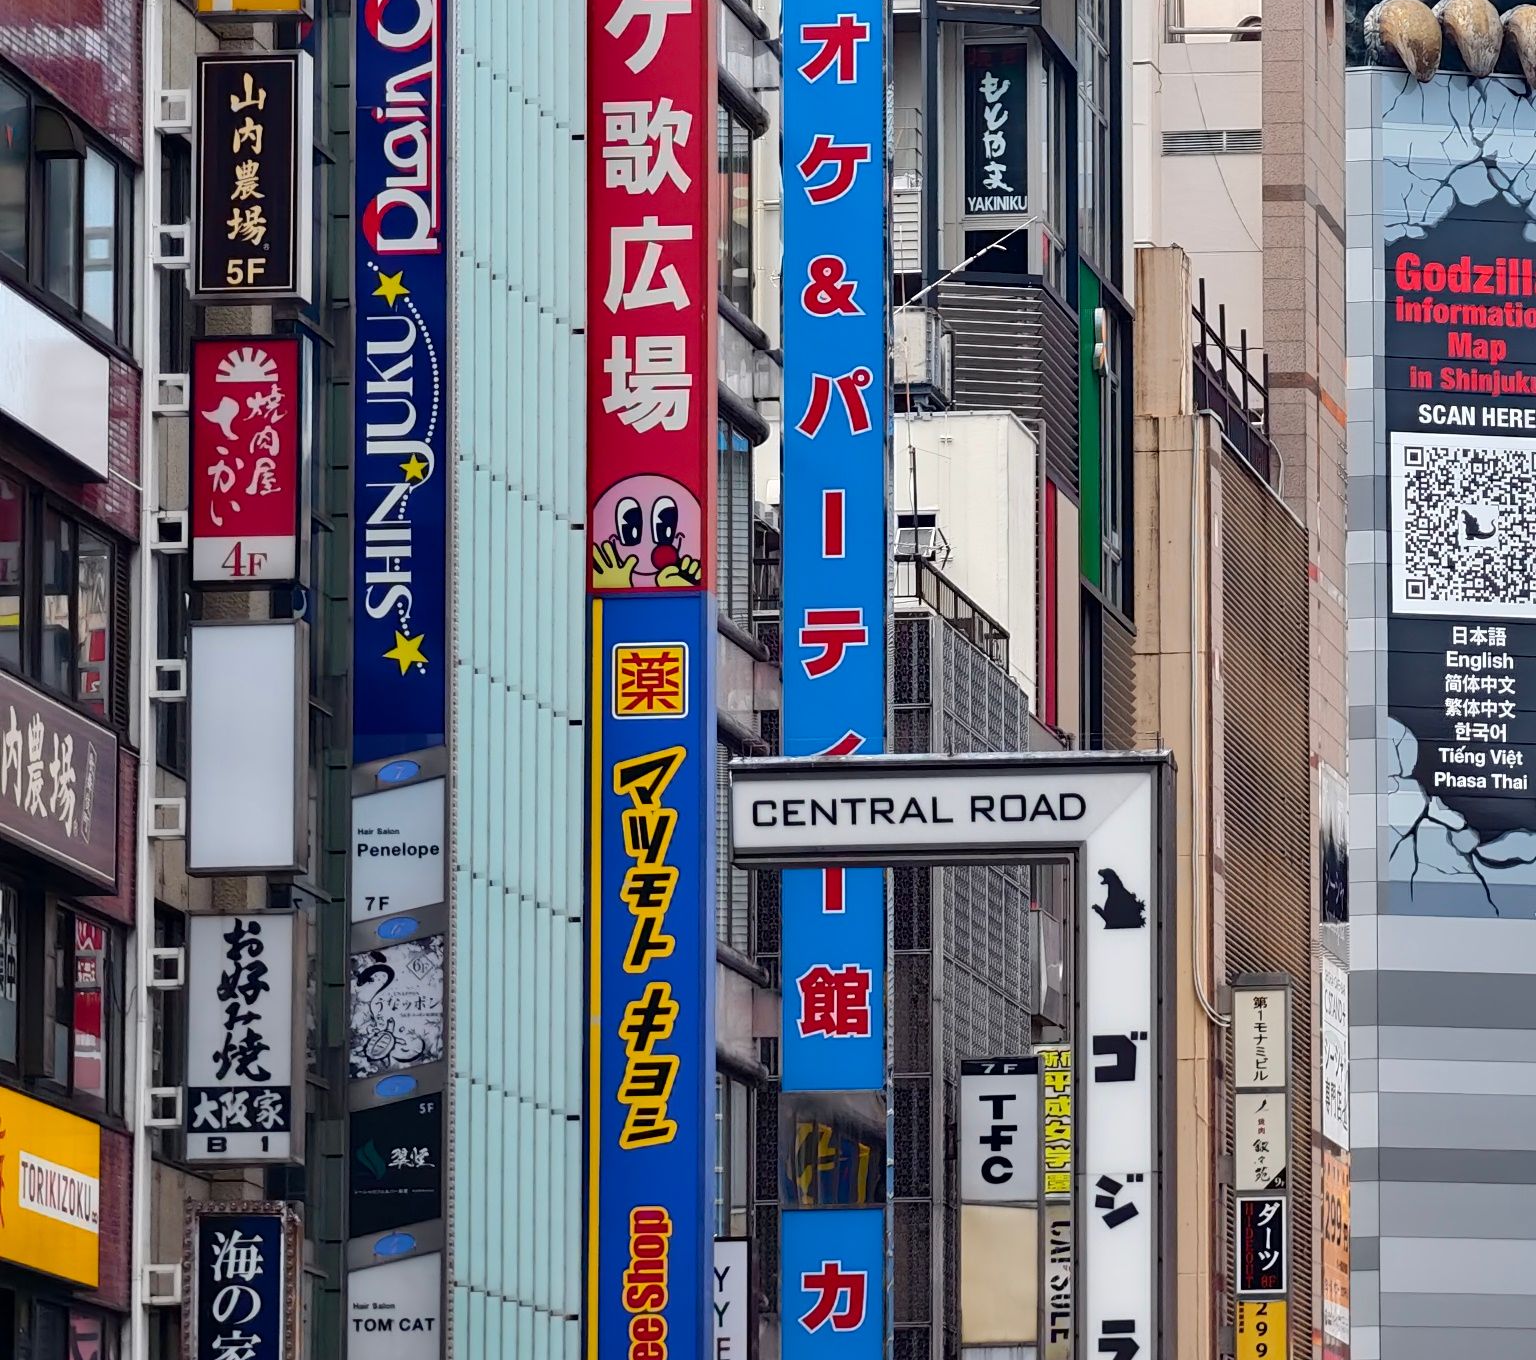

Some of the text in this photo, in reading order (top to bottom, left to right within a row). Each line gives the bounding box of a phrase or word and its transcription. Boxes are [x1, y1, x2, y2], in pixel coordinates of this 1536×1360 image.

[227, 73, 269, 248] 山内農場
[967, 195, 1028, 213] YAKINIKU
[226, 257, 266, 285] 5F
[1447, 330, 1508, 363] Map
[1409, 365, 1434, 391] in
[1417, 404, 1536, 430] SCAN HERE
[365, 314, 432, 621] SHINJUKU
[220, 539, 269, 579] 4F
[1452, 625, 1507, 647] 日本語
[1446, 650, 1514, 672] English
[619, 650, 683, 711] 薬
[1445, 674, 1516, 695] 简体中文
[1445, 697, 1516, 719] 繁体中文
[1454, 722, 1508, 743] 한국어
[1438, 745, 1524, 769] Tiếng Việt
[1434, 771, 1528, 790] Phasa Thai
[752, 792, 1087, 828] CENTRAL ROAD
[357, 842, 440, 859] Penelope
[365, 896, 390, 911] 7F
[612, 746, 687, 1150] マツモトキヨシ
[212, 918, 272, 1083] お好み焼
[1252, 996, 1269, 1081] 第1モナミビル
[980, 1063, 1018, 1075] 7F
[192, 1090, 286, 1132] 大阪家
[419, 1103, 435, 1114] 5F
[20, 1157, 92, 1224] TORIKIZOKU
[1257, 1201, 1281, 1271] ダーツ
[353, 1317, 435, 1333] TOM CAT
